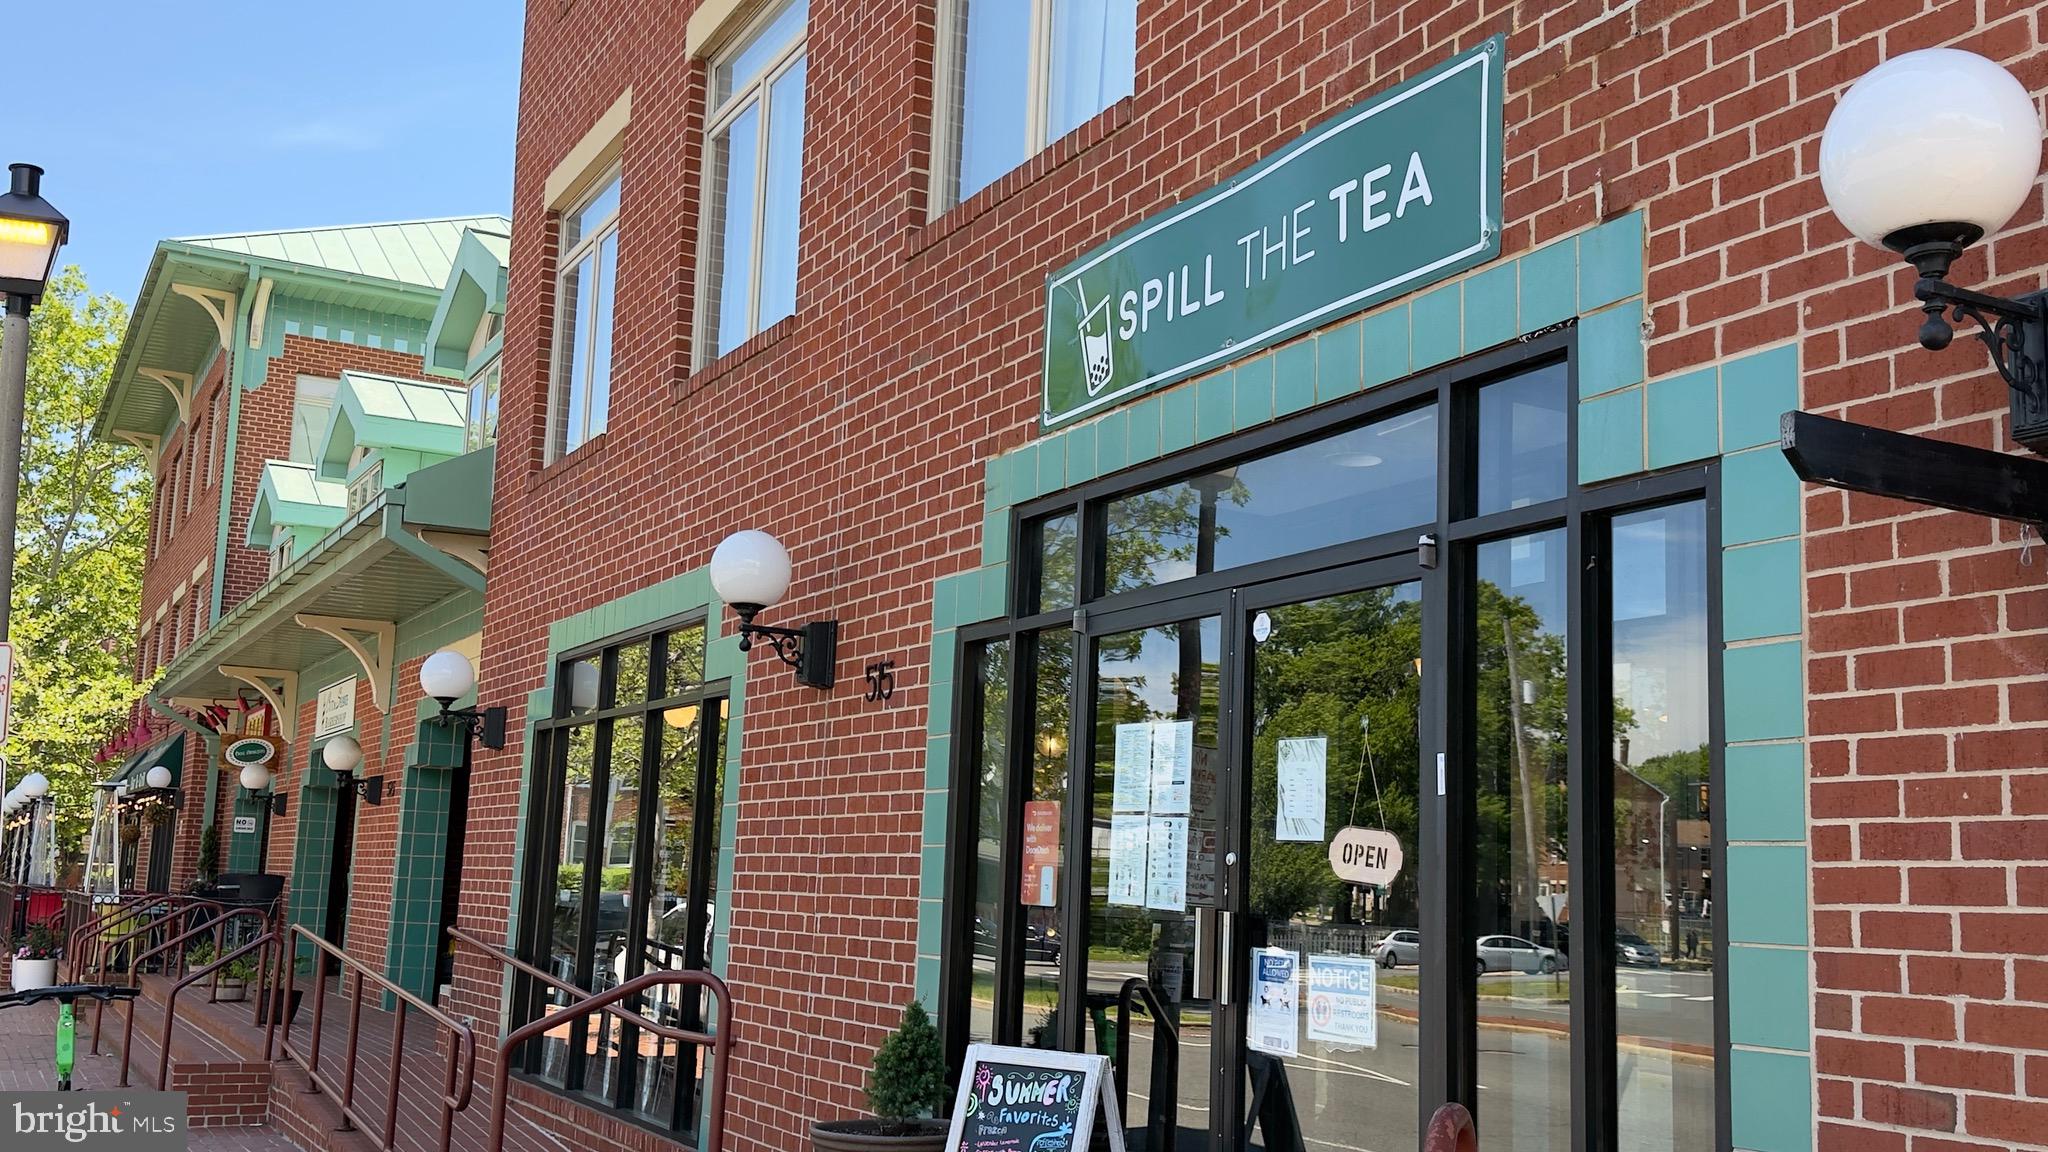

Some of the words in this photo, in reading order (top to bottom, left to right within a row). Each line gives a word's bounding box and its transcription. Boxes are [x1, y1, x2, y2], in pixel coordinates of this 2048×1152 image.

[1119, 254, 1224, 340] SPILL
[1237, 200, 1315, 288] THE
[1328, 151, 1433, 243] TEA
[1026, 823, 1036, 832] We
[1026, 835, 1037, 843] with
[1342, 842, 1389, 870] OPEN
[1264, 957, 1273, 967] NO
[1262, 968, 1290, 979] ALLOWED
[1310, 966, 1370, 992] NOTICE
[1335, 996, 1345, 1005] NO
[1334, 1022, 1354, 1033] THANK
[1354, 1024, 1368, 1034] YOU
[988, 1074, 1071, 1106] SUMMER
[999, 1107, 1059, 1127] Favorites
